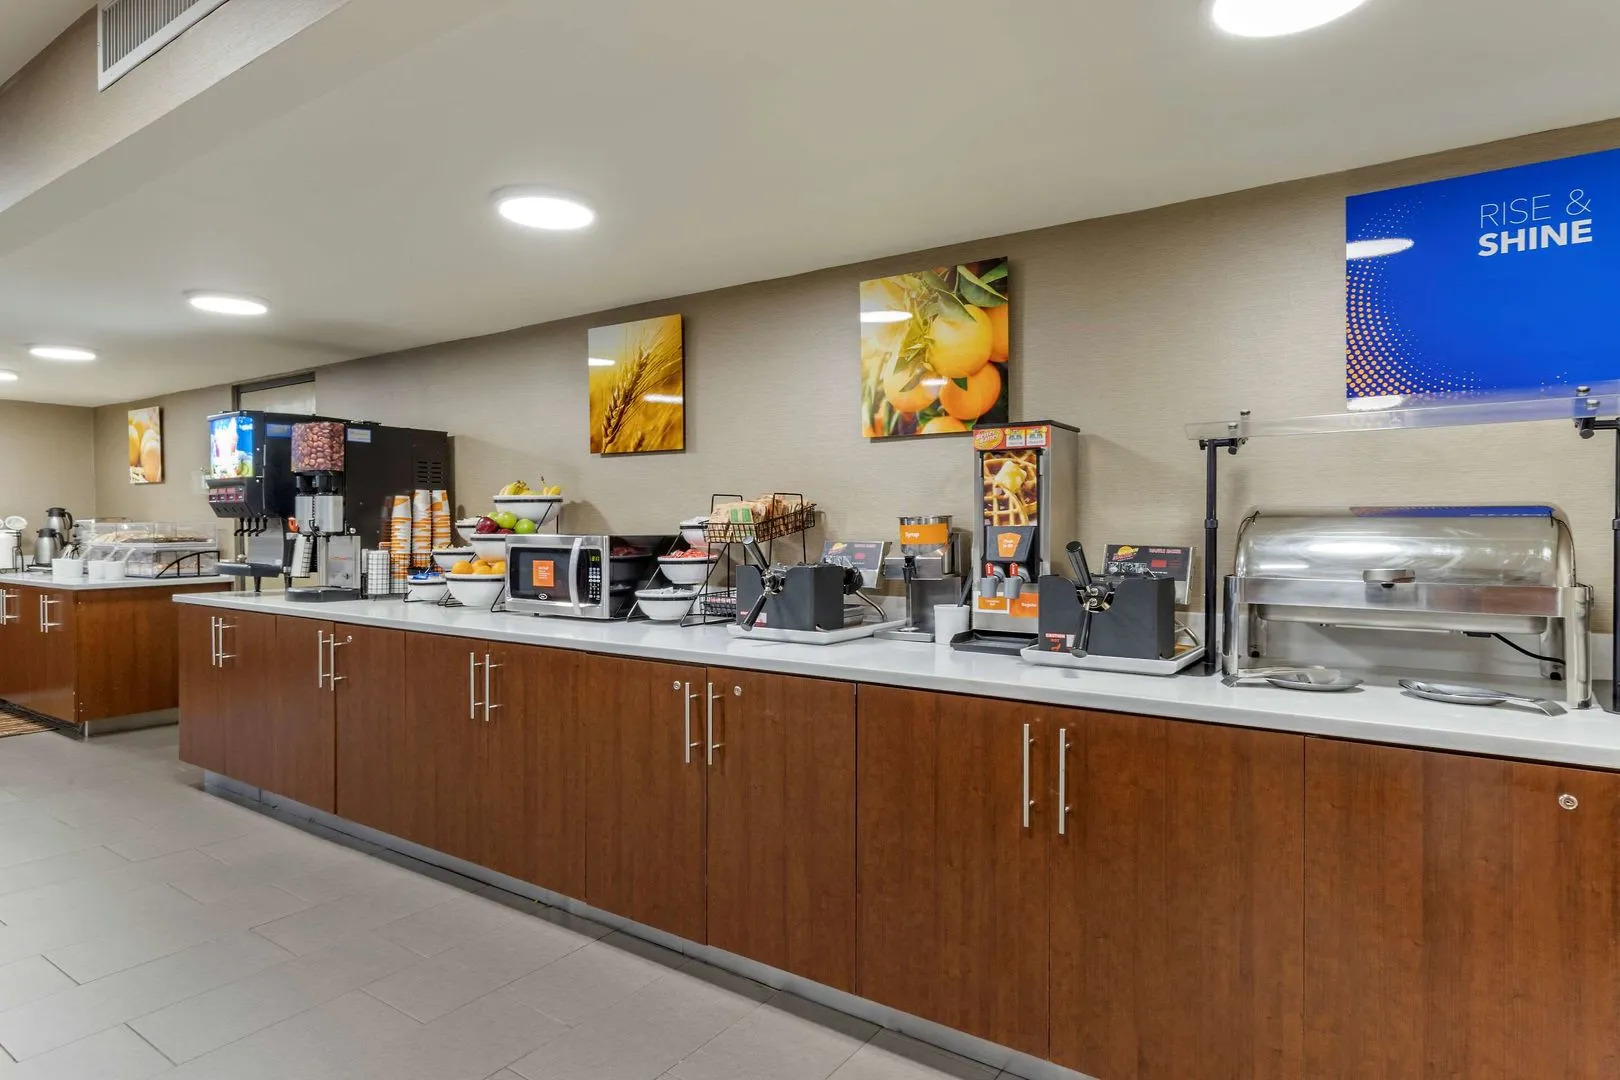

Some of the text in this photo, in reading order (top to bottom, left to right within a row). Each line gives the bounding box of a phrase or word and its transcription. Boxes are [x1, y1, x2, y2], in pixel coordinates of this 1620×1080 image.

[1480, 188, 1592, 229] RISE &
[1478, 218, 1593, 257] SHINE
